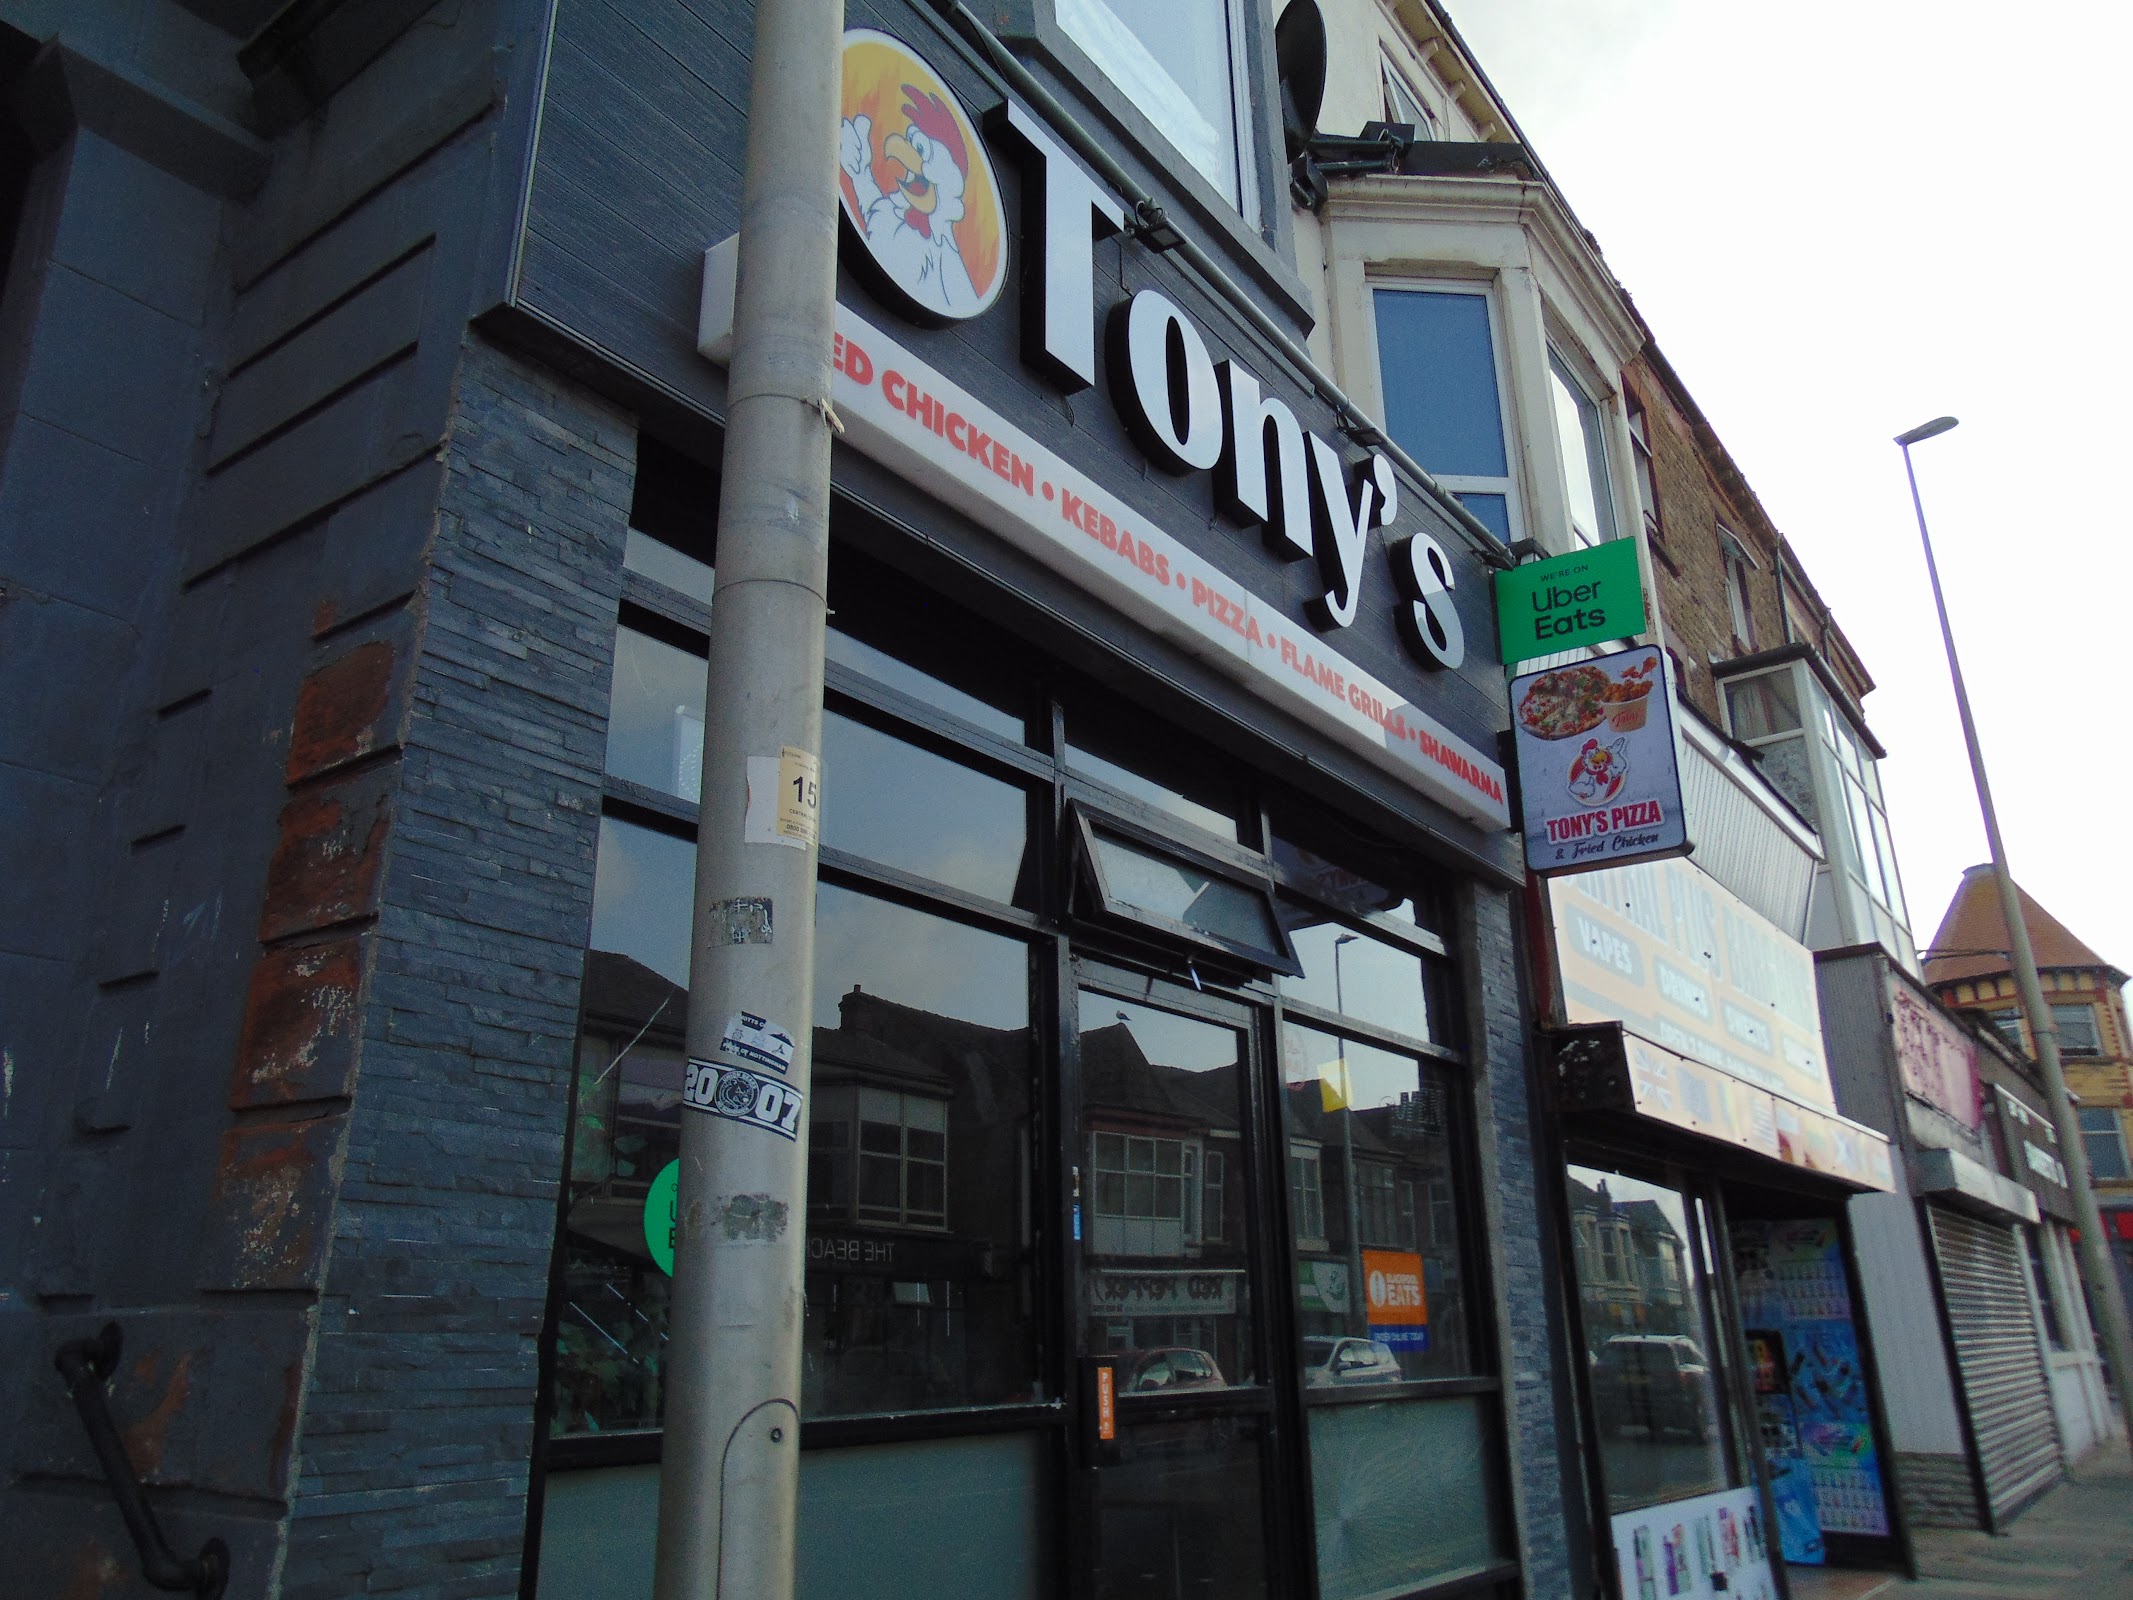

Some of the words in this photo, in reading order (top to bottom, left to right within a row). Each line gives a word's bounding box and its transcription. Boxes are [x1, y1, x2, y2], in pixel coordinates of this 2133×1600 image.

[1004, 98, 1465, 670] Tony's
[881, 369, 1034, 497] CHICKEN
[1061, 487, 1171, 587] KEBABS
[1191, 576, 1264, 649] PIZZA
[1280, 636, 1346, 702] FLAME
[1348, 683, 1407, 740] GRILLS
[1419, 729, 1504, 805] SHAWARMA
[1540, 568, 1571, 582] WE'RE
[1573, 564, 1589, 575] ON
[1531, 580, 1602, 613] Uber
[1534, 607, 1606, 640] Eats
[792, 775, 817, 809] 15
[1546, 809, 1609, 842] TONY'S
[1611, 800, 1662, 830] PIZZA
[1555, 847, 1565, 860] &
[1571, 840, 1606, 859] Fried
[1612, 832, 1660, 851] Chicken
[1386, 1284, 1421, 1306] EATS
